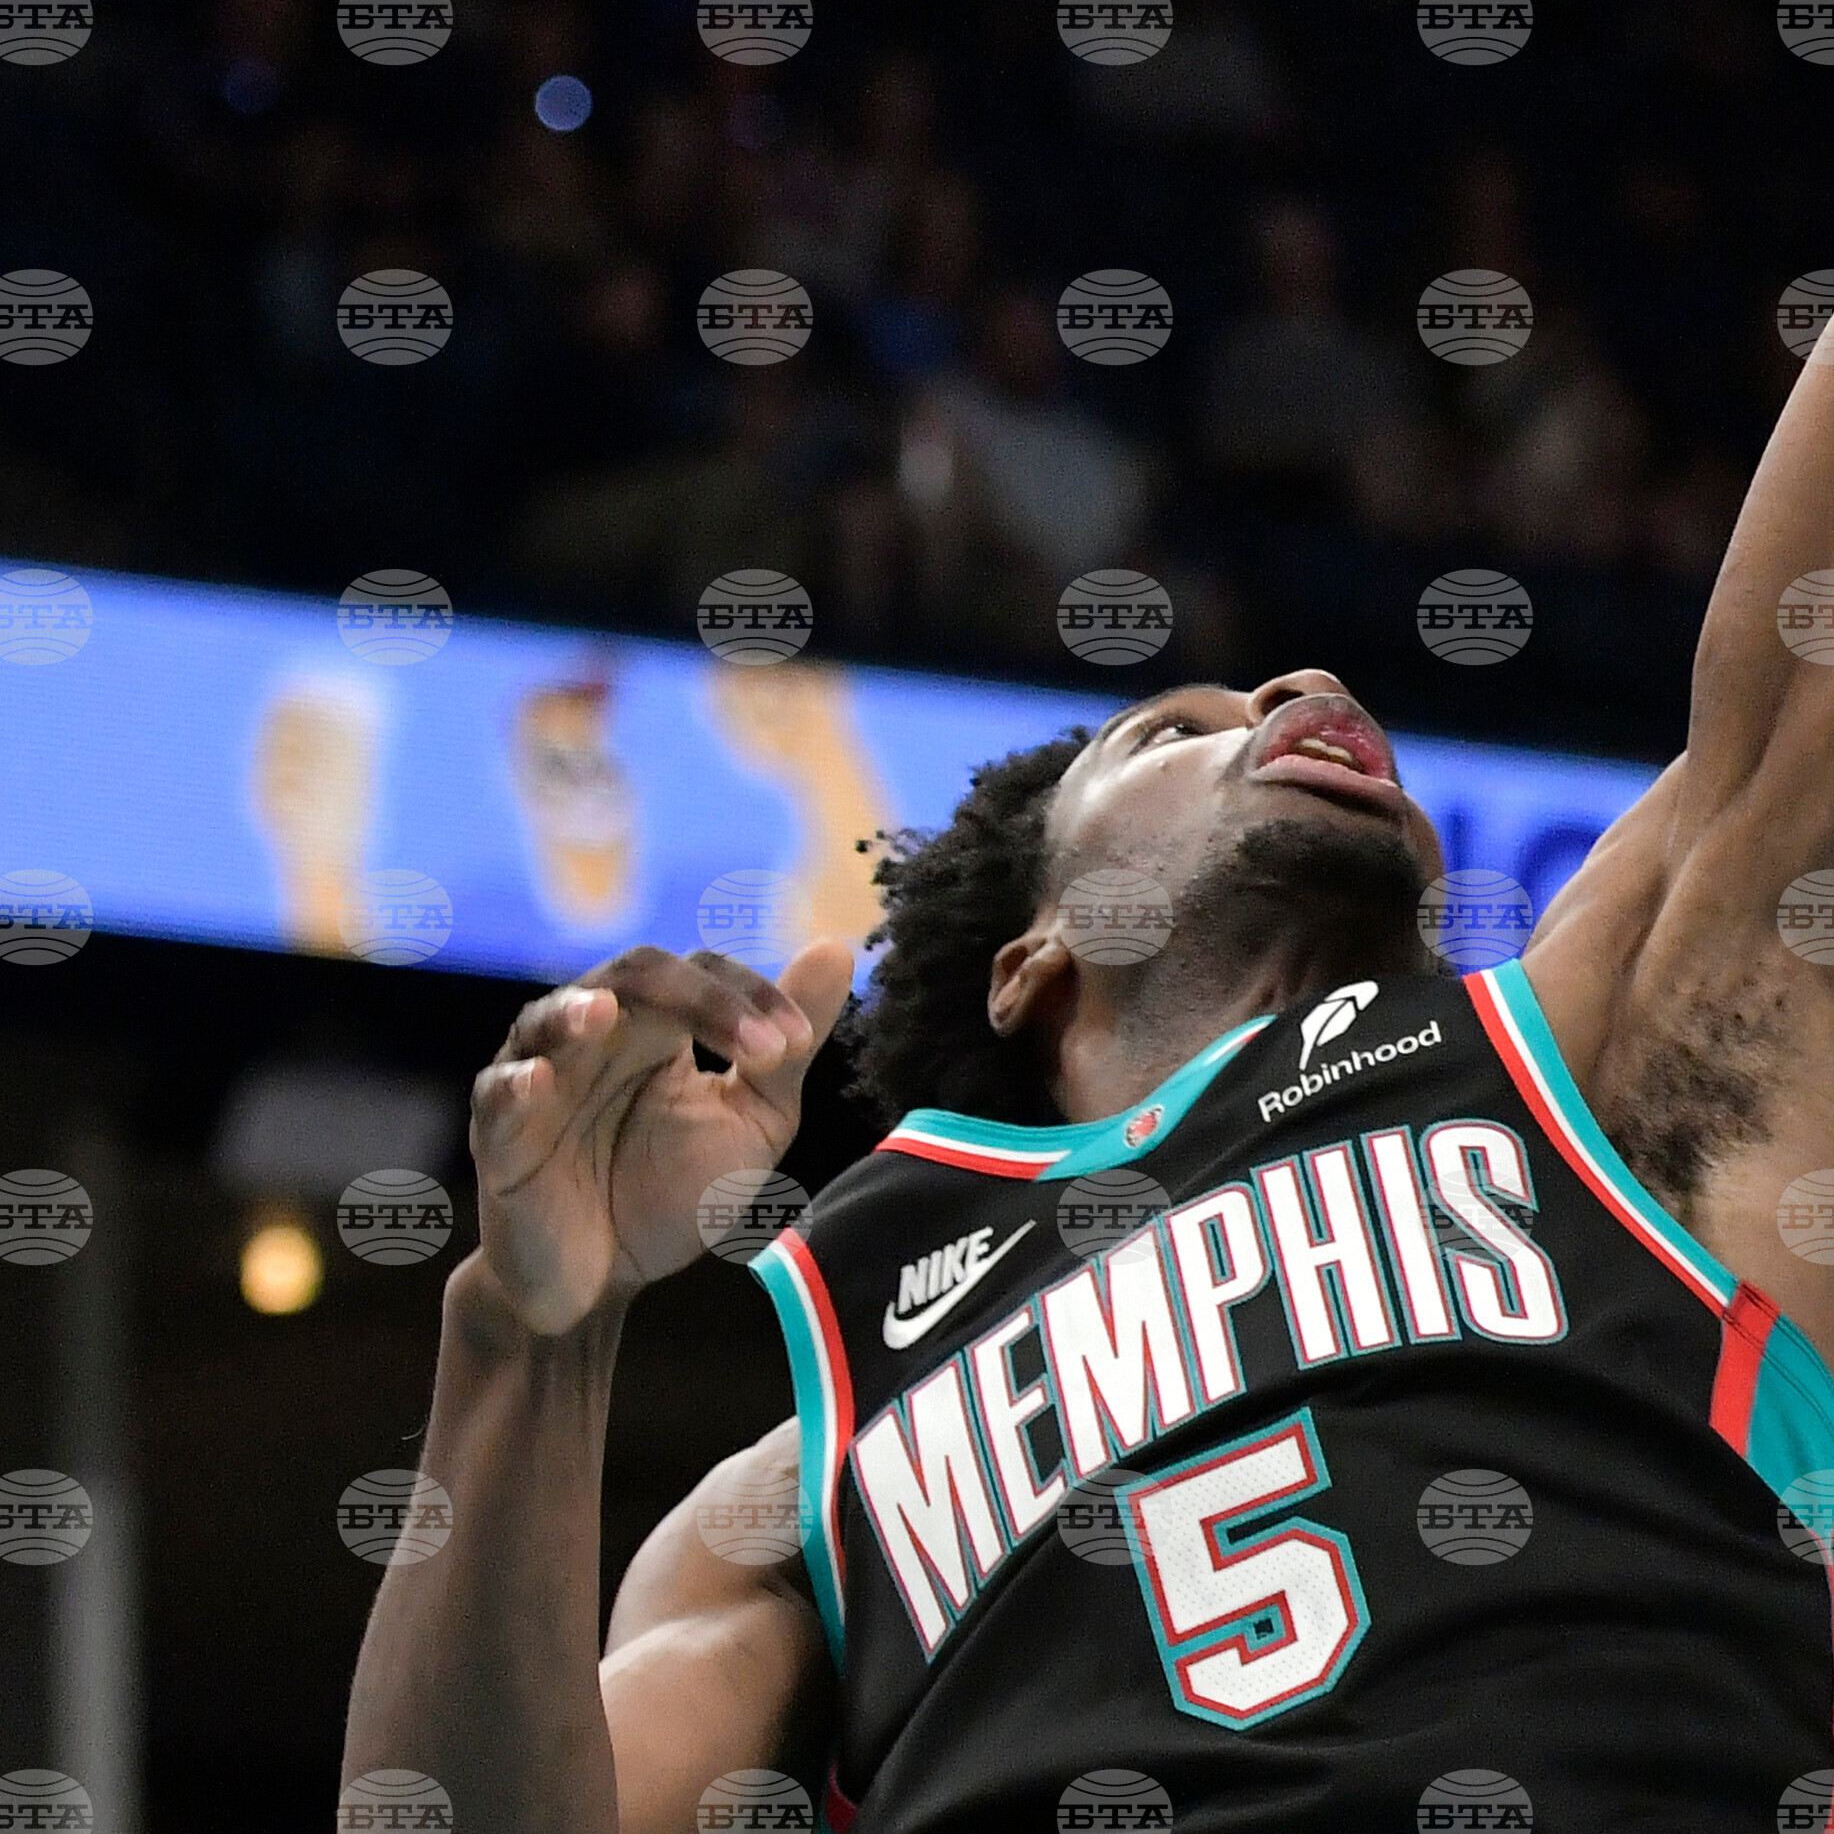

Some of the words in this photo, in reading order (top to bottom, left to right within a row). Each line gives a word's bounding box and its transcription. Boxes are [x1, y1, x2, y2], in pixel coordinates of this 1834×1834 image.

[1258, 1020, 1442, 1122] Robinhood
[898, 1226, 994, 1313] NIKE
[848, 1119, 1568, 1662] MEMPHIS
[1116, 1407, 1371, 1731] 5
